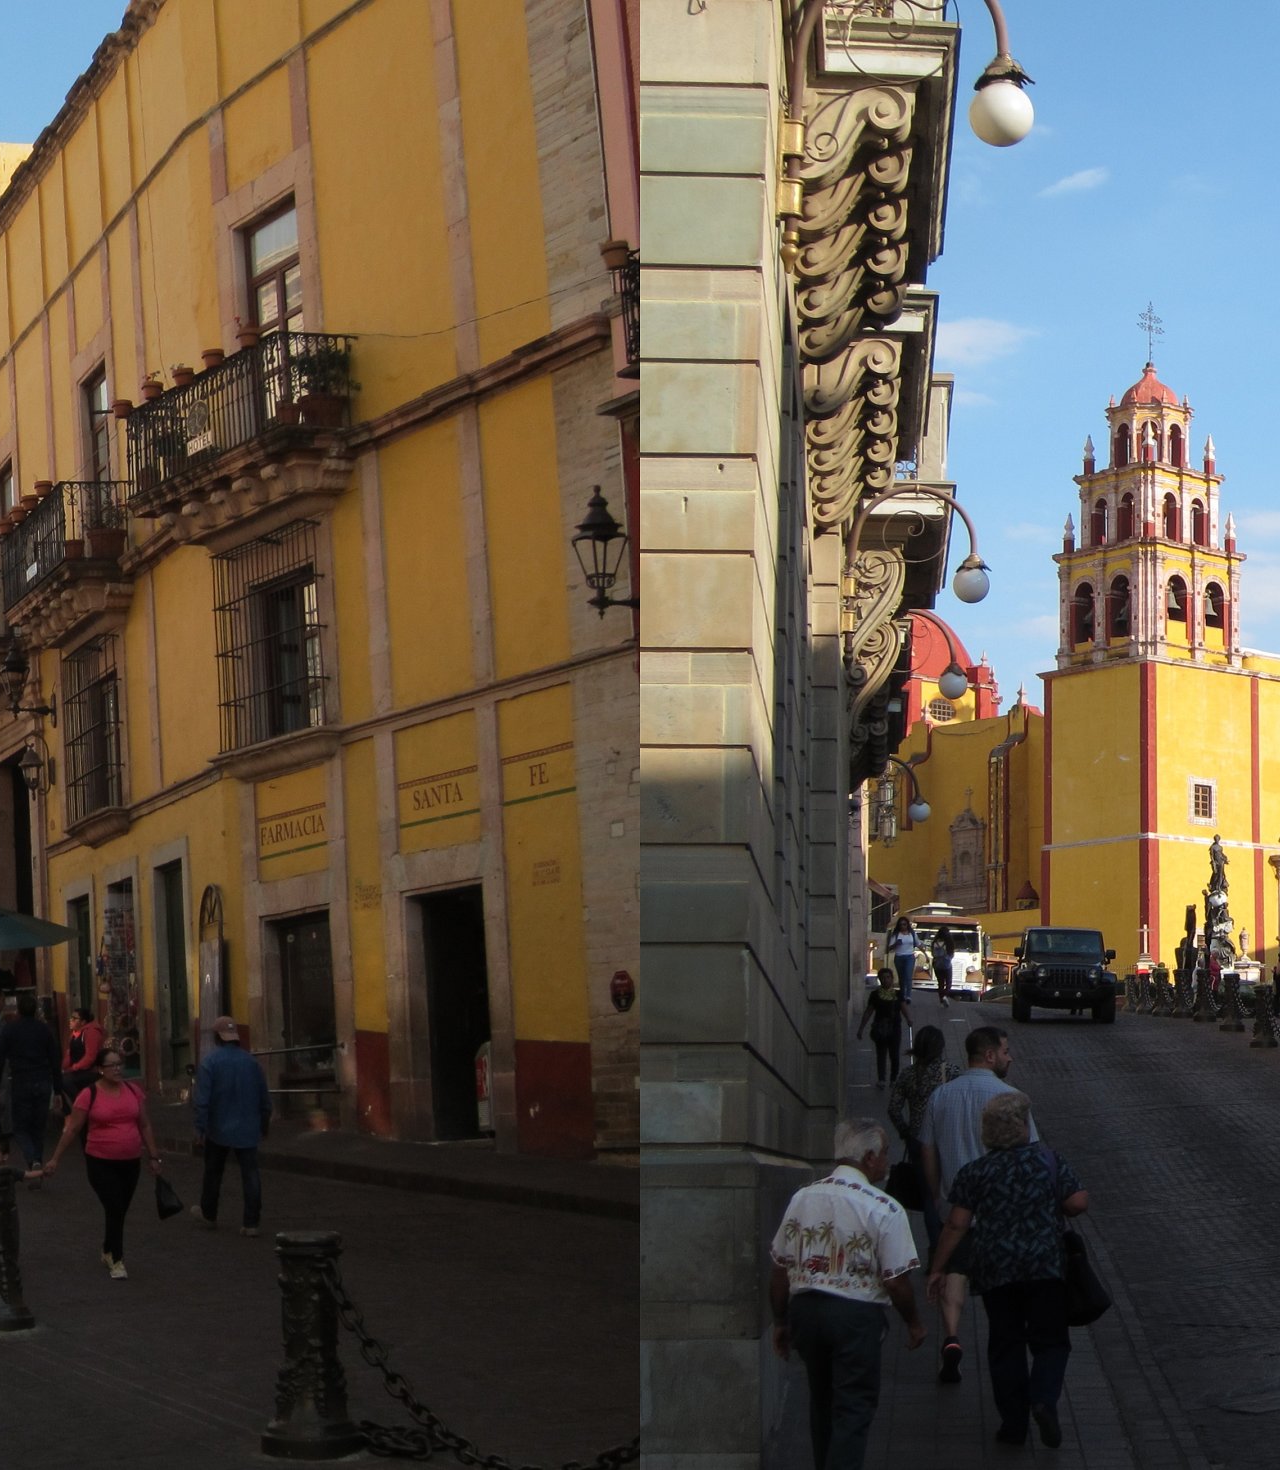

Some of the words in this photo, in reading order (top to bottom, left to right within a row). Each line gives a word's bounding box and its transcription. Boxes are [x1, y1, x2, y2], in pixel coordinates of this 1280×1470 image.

[260, 815, 325, 846] FARMACIA
[413, 782, 463, 811] SANTA
[530, 763, 549, 787] FE
